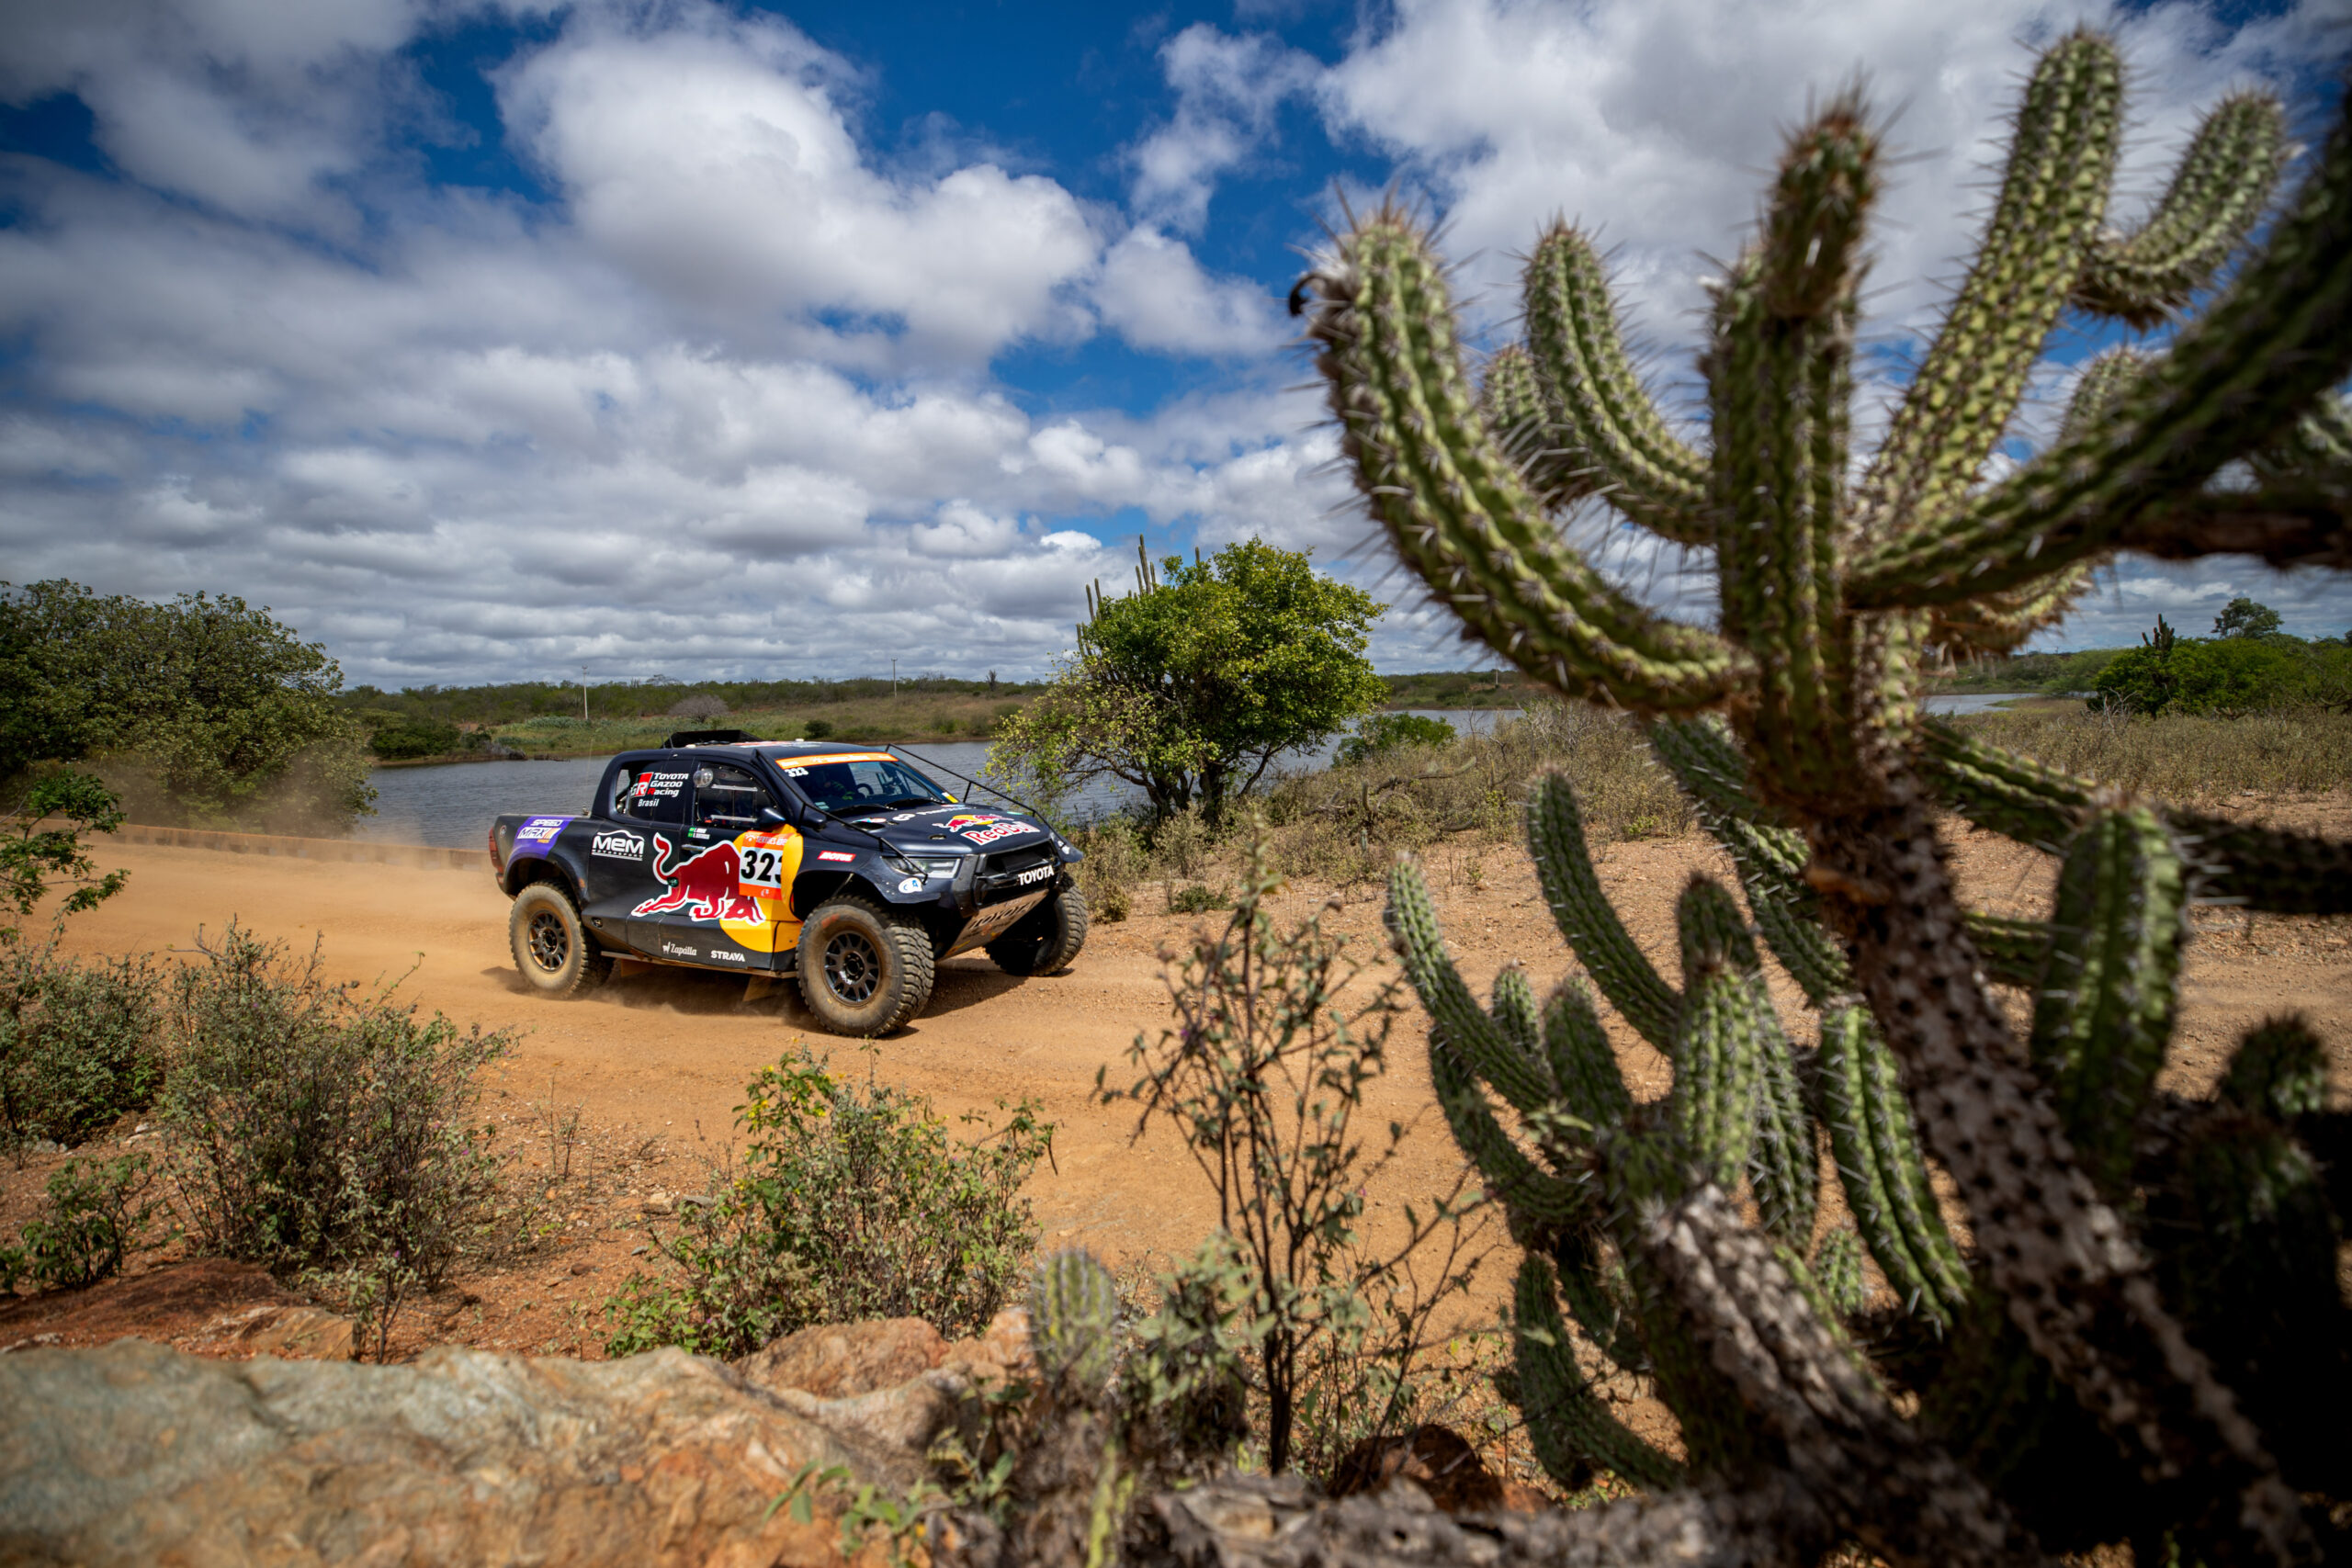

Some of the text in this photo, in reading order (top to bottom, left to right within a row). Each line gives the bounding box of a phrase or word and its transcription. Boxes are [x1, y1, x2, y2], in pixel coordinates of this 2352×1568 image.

[785, 767, 809, 778] 323
[650, 780, 683, 788] GAZOO
[647, 788, 679, 797] Racing
[638, 798, 660, 807] Brasil
[820, 852, 854, 862] MOTUL
[1018, 864, 1055, 886] TOYOTA
[710, 950, 745, 962] STRAVA
